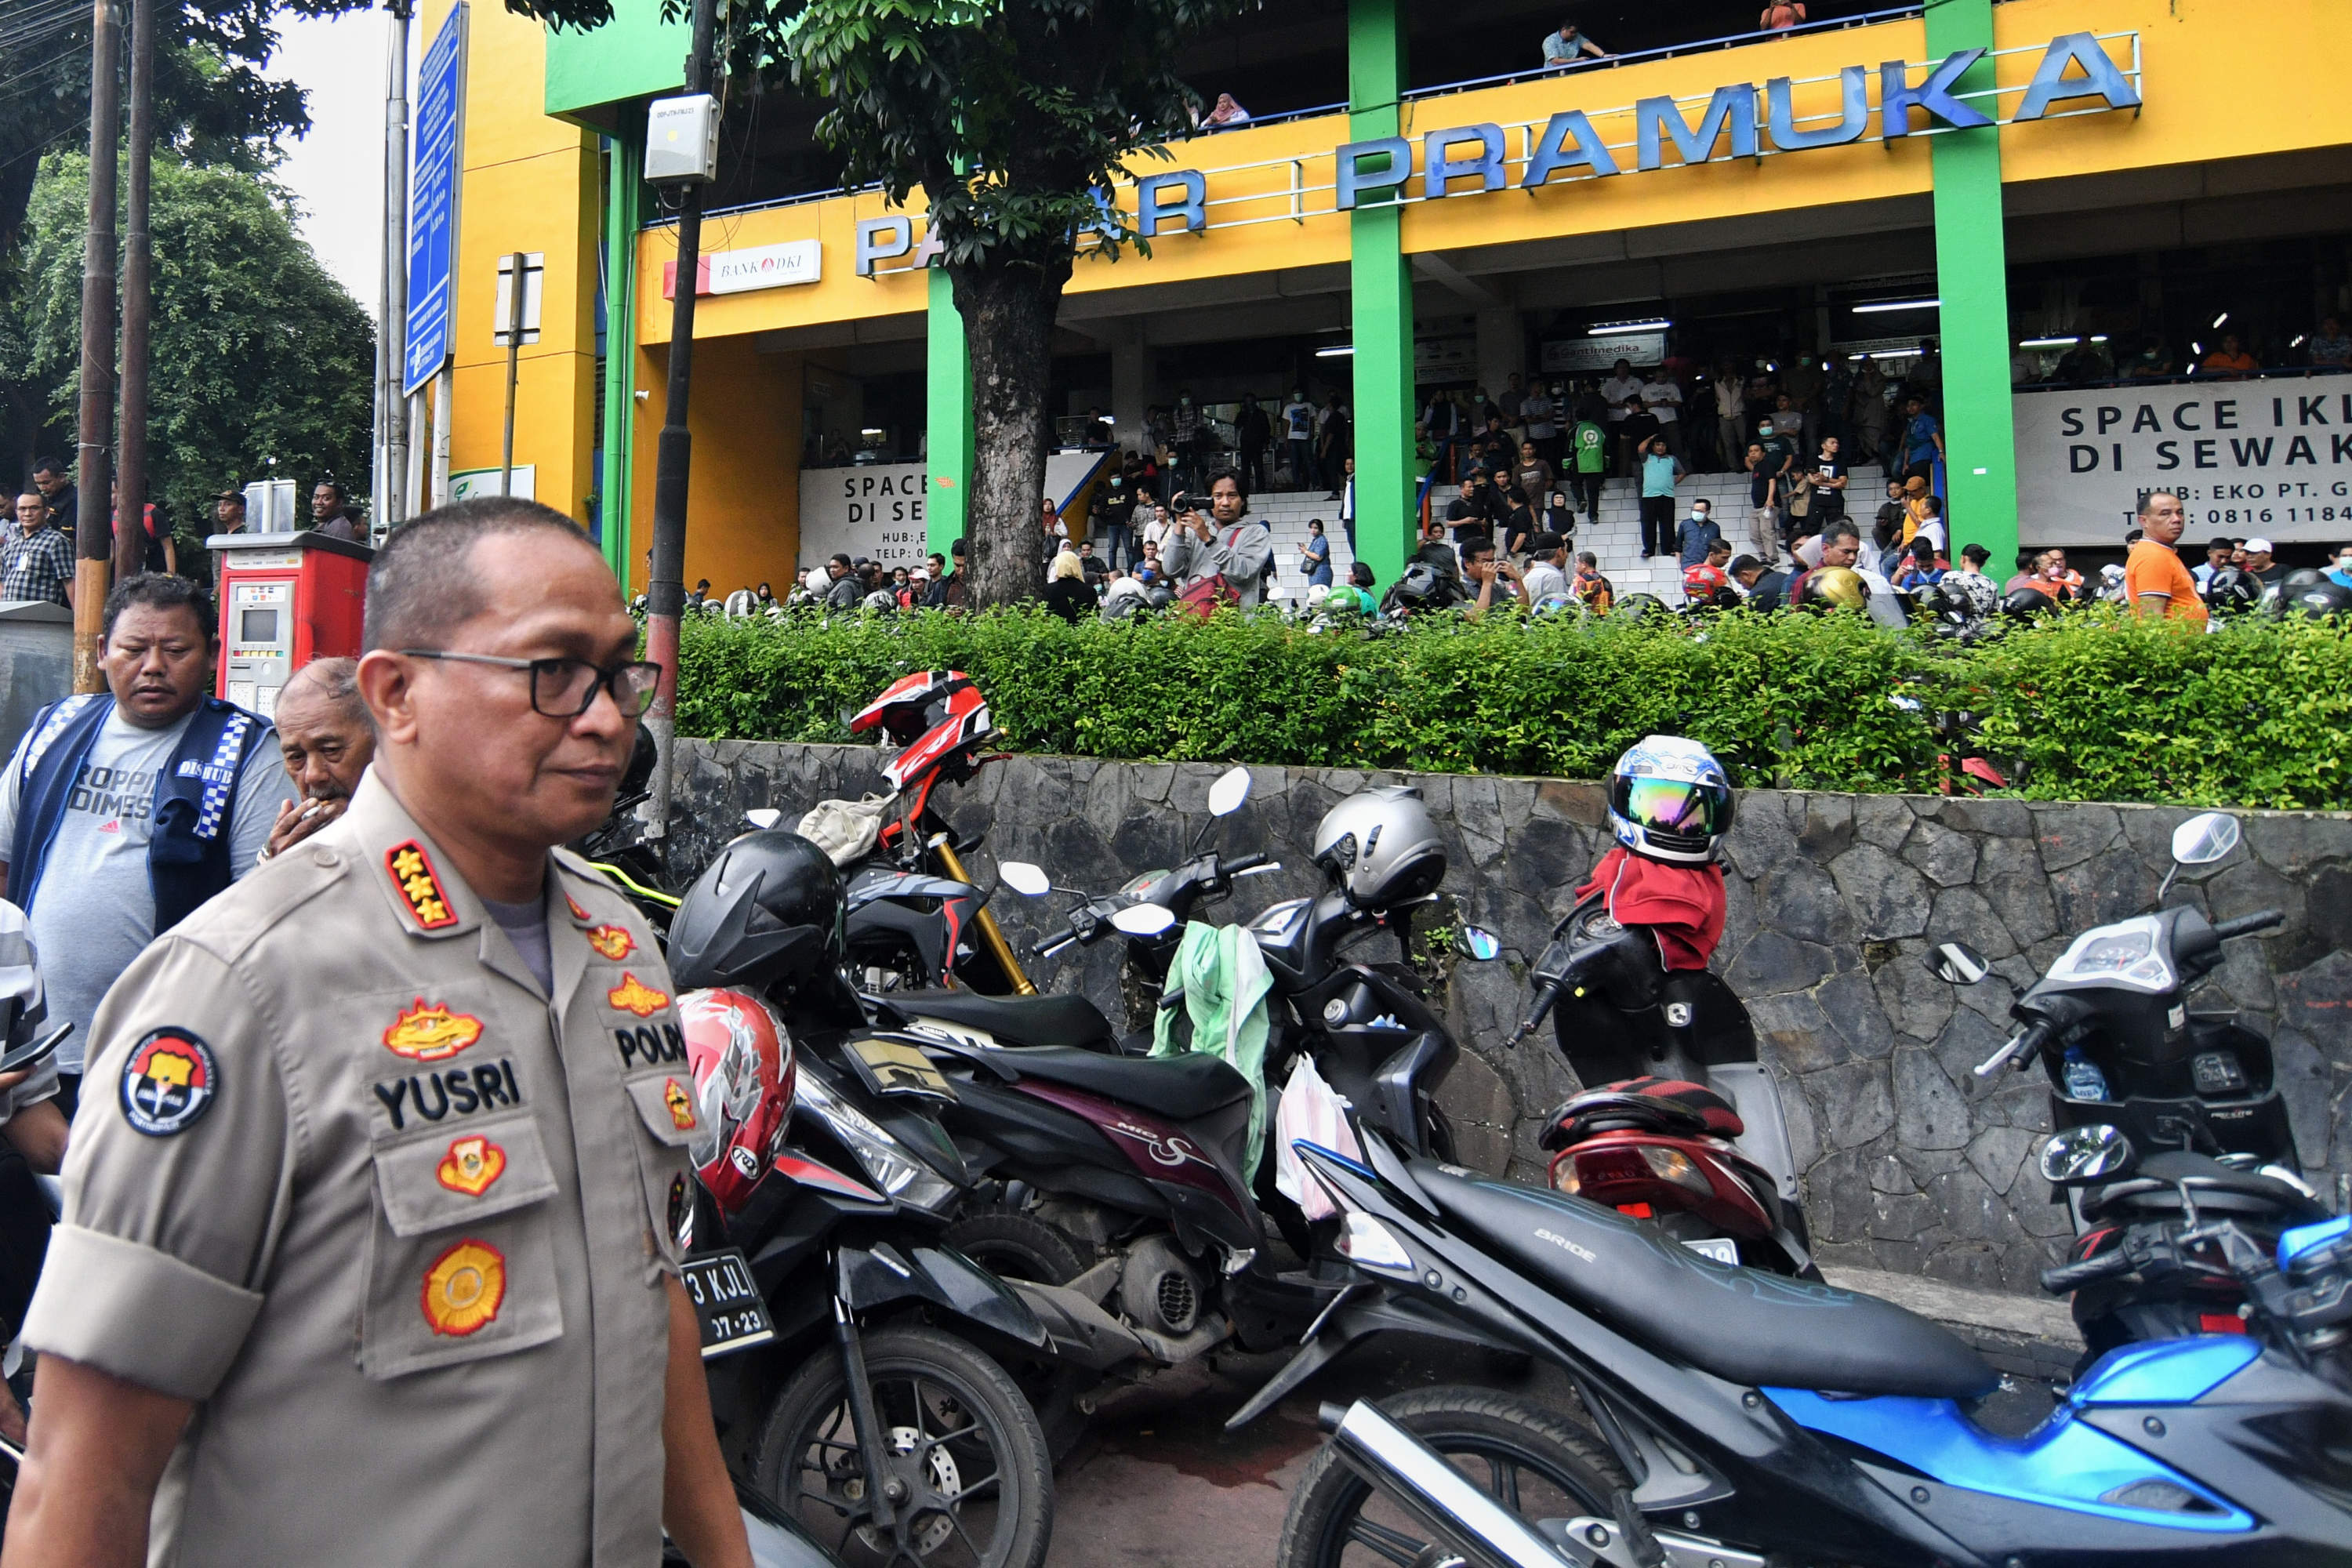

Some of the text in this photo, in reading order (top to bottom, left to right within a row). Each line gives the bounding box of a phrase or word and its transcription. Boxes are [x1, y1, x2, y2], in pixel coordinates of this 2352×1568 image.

[1335, 31, 2142, 209] PRAMUKA
[721, 255, 802, 278] BANK DKI
[2061, 399, 2238, 437] SPACE
[2069, 433, 2352, 474] DI SEWAK
[2213, 484, 2264, 499] EKO
[2278, 482, 2318, 499] PT.
[848, 503, 874, 523] DI
[2207, 508, 2273, 524] 0816
[2287, 506, 2352, 522] 1184
[876, 548, 911, 559] TELP:
[883, 532, 913, 543] HUB:
[177, 758, 234, 785] DISHUB
[69, 787, 152, 820] DIMES
[615, 1022, 688, 1069] POLRI
[374, 1058, 520, 1130] YUSRI
[1534, 1228, 1596, 1264] BRIDE
[706, 1264, 750, 1301] KJL
